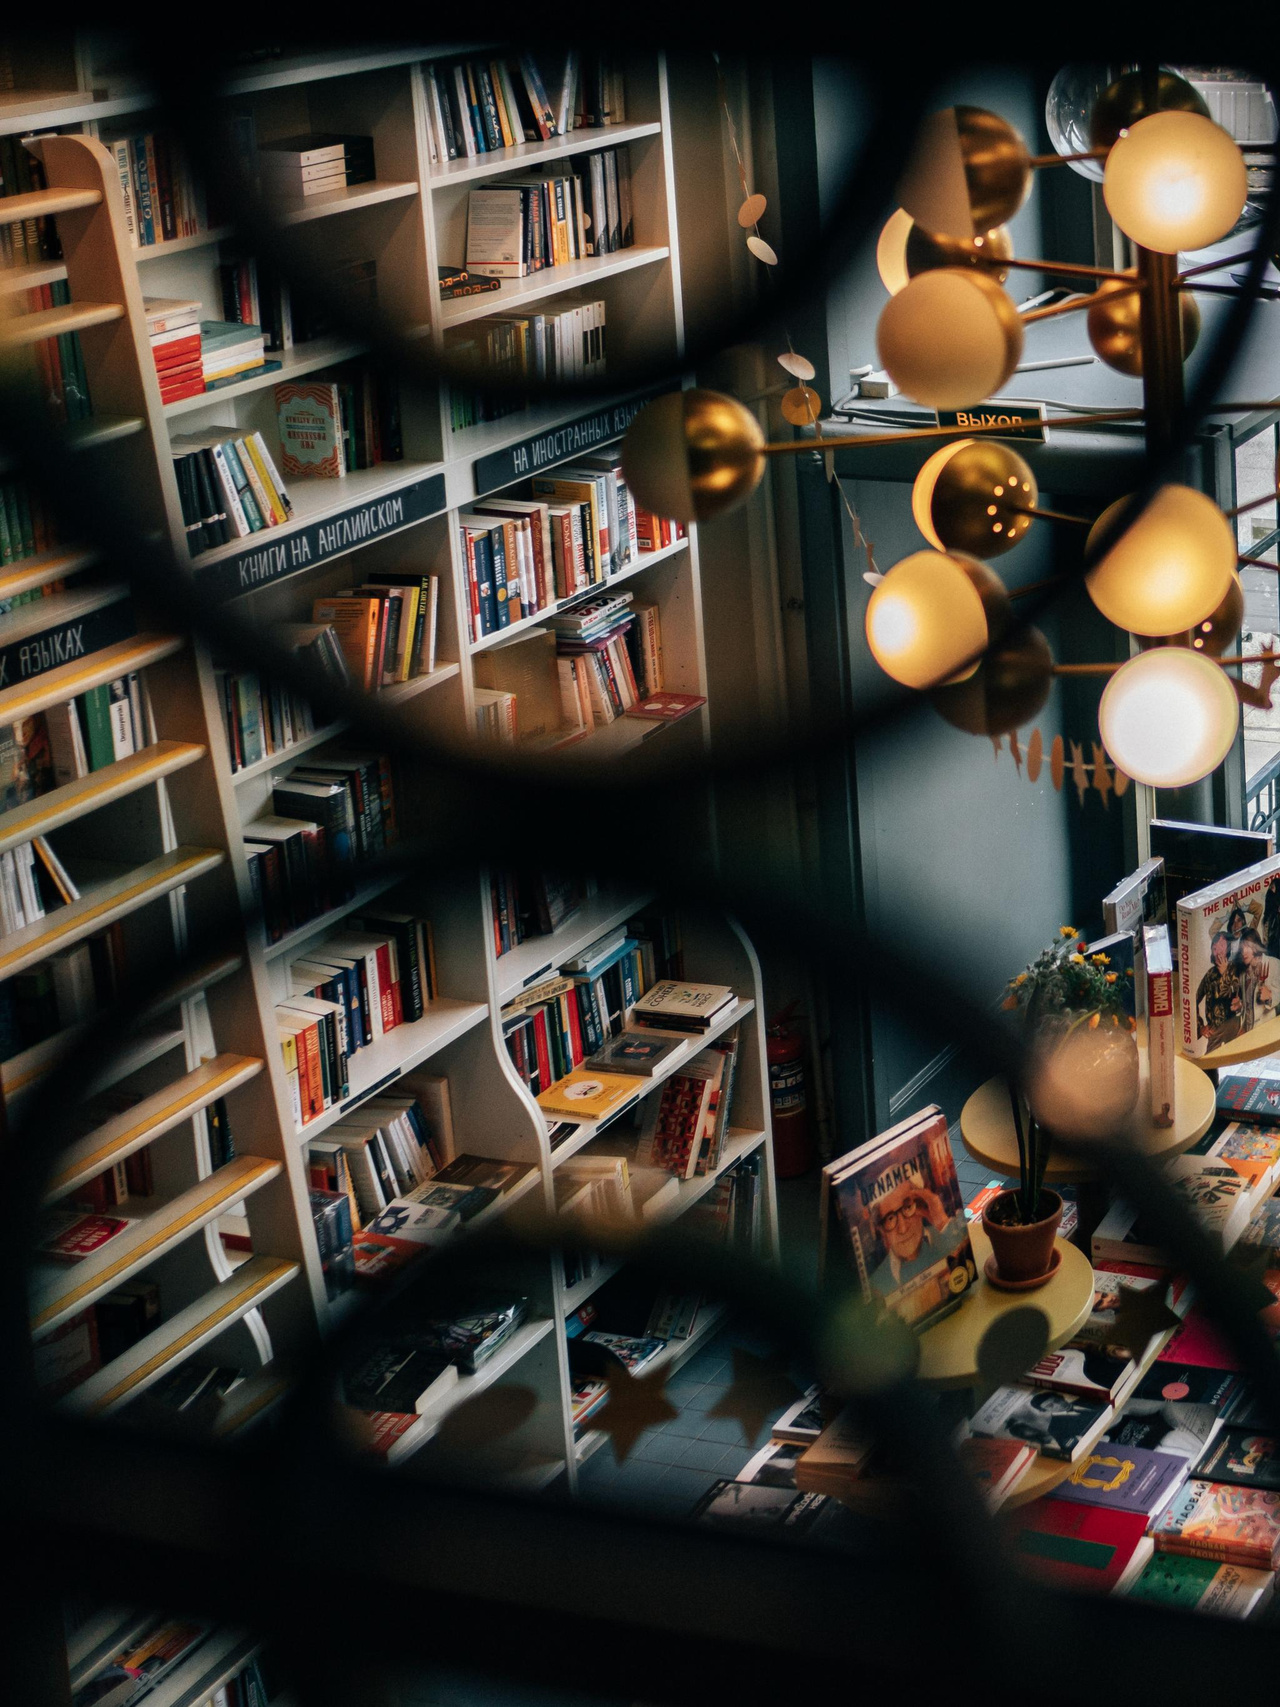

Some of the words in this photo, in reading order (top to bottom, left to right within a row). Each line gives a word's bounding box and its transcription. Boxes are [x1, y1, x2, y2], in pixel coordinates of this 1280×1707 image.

[439, 272, 469, 288] CIRC
[453, 280, 500, 297] CIRCE
[513, 448, 529, 474] НА
[532, 413, 610, 466] ИНОСТРАННЫХ
[238, 544, 287, 587] КНИГИ
[291, 536, 311, 565] НА
[318, 497, 404, 550] АНГЛИЙСКОМ
[562, 517, 571, 549] ROME
[627, 511, 636, 541] BERLIN
[508, 520, 519, 577] GORBACHEV
[19, 624, 84, 676] ЯЗЫКАХ
[1203, 901, 1219, 917] THE
[1222, 883, 1262, 906] ROLLING
[1181, 918, 1189, 941] THE
[1182, 945, 1191, 995] ROLLING
[649, 983, 678, 1008] COHEN
[1152, 976, 1168, 1013] MARVEL
[1182, 997, 1192, 1044] STONES
